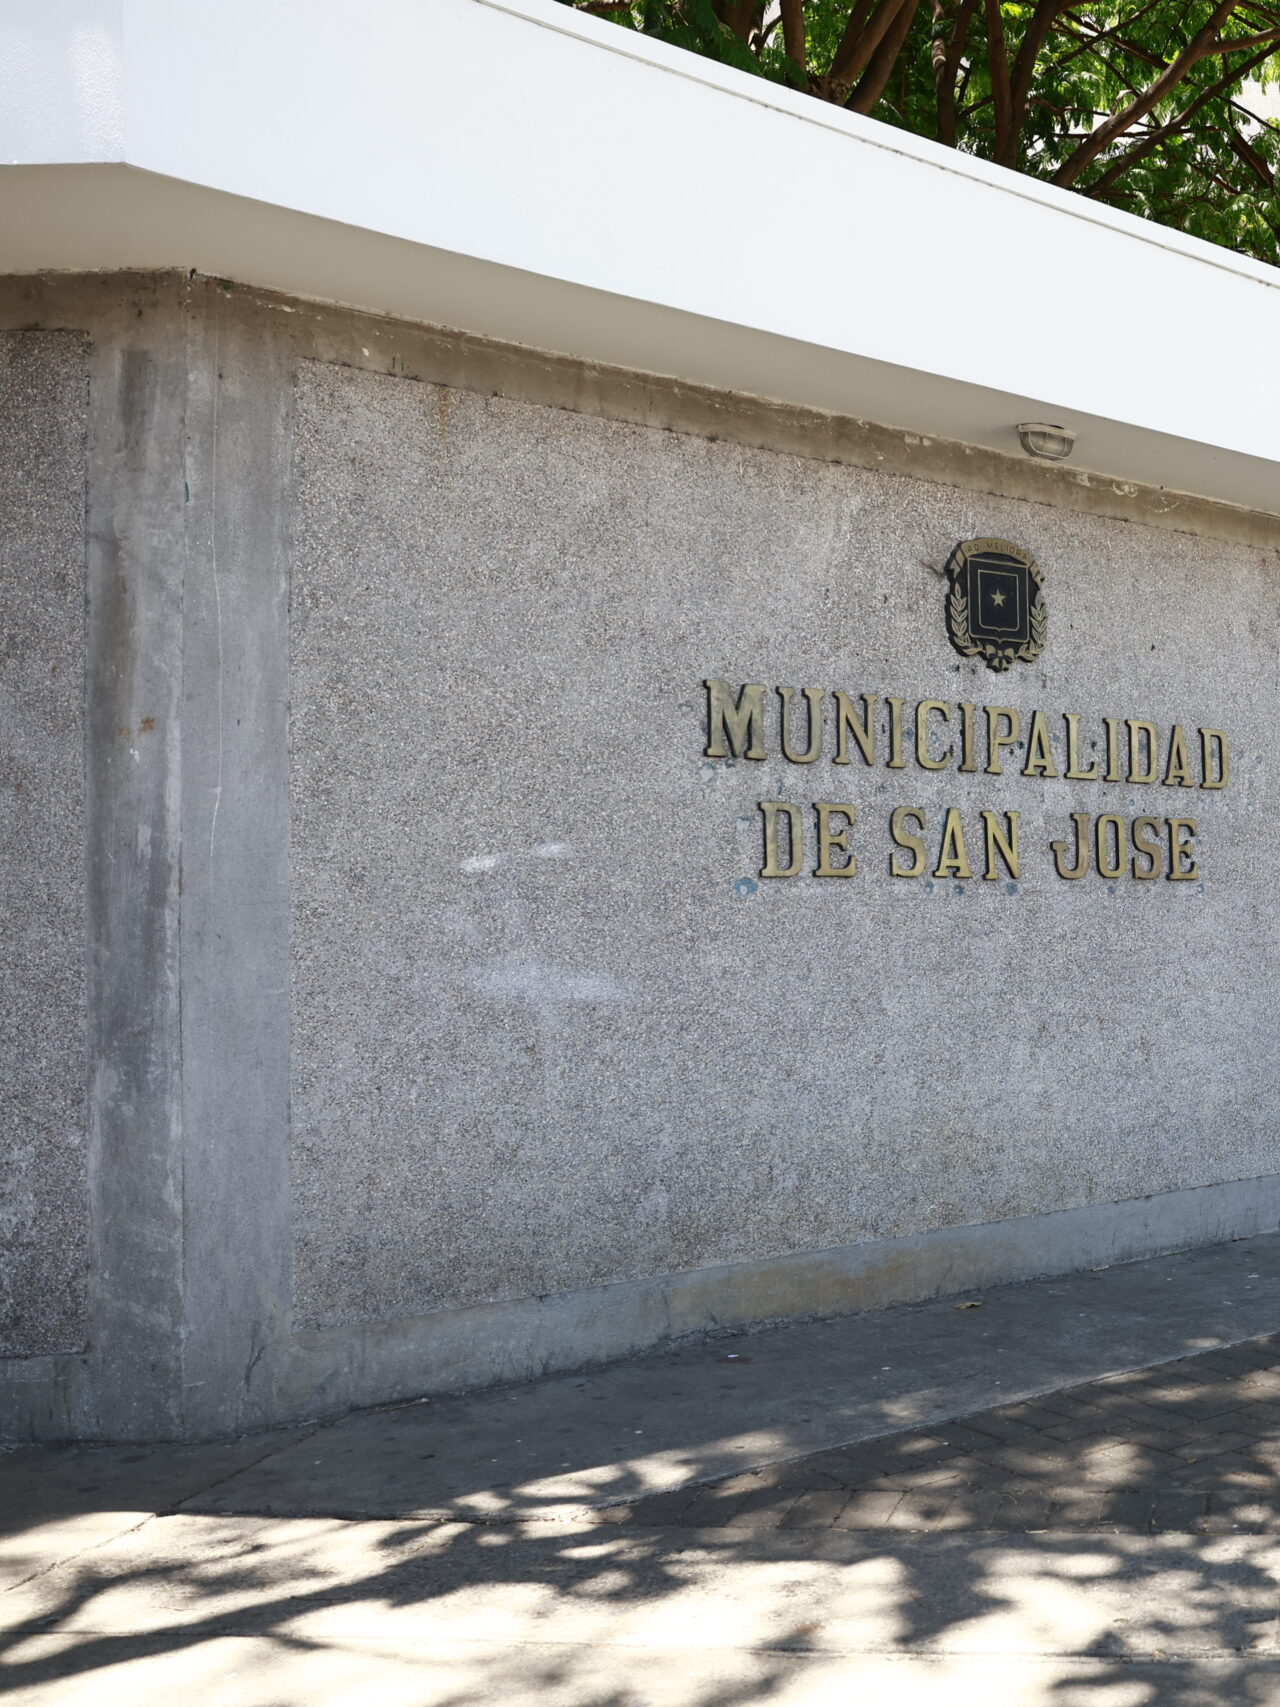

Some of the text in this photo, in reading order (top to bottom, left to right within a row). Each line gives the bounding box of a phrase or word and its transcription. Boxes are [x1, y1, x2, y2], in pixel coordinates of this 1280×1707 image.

[967, 542, 1027, 560] AD MELIORA
[703, 680, 1230, 789] MUNICIPALIDAD
[758, 801, 1198, 881] DE SAN JOSE
